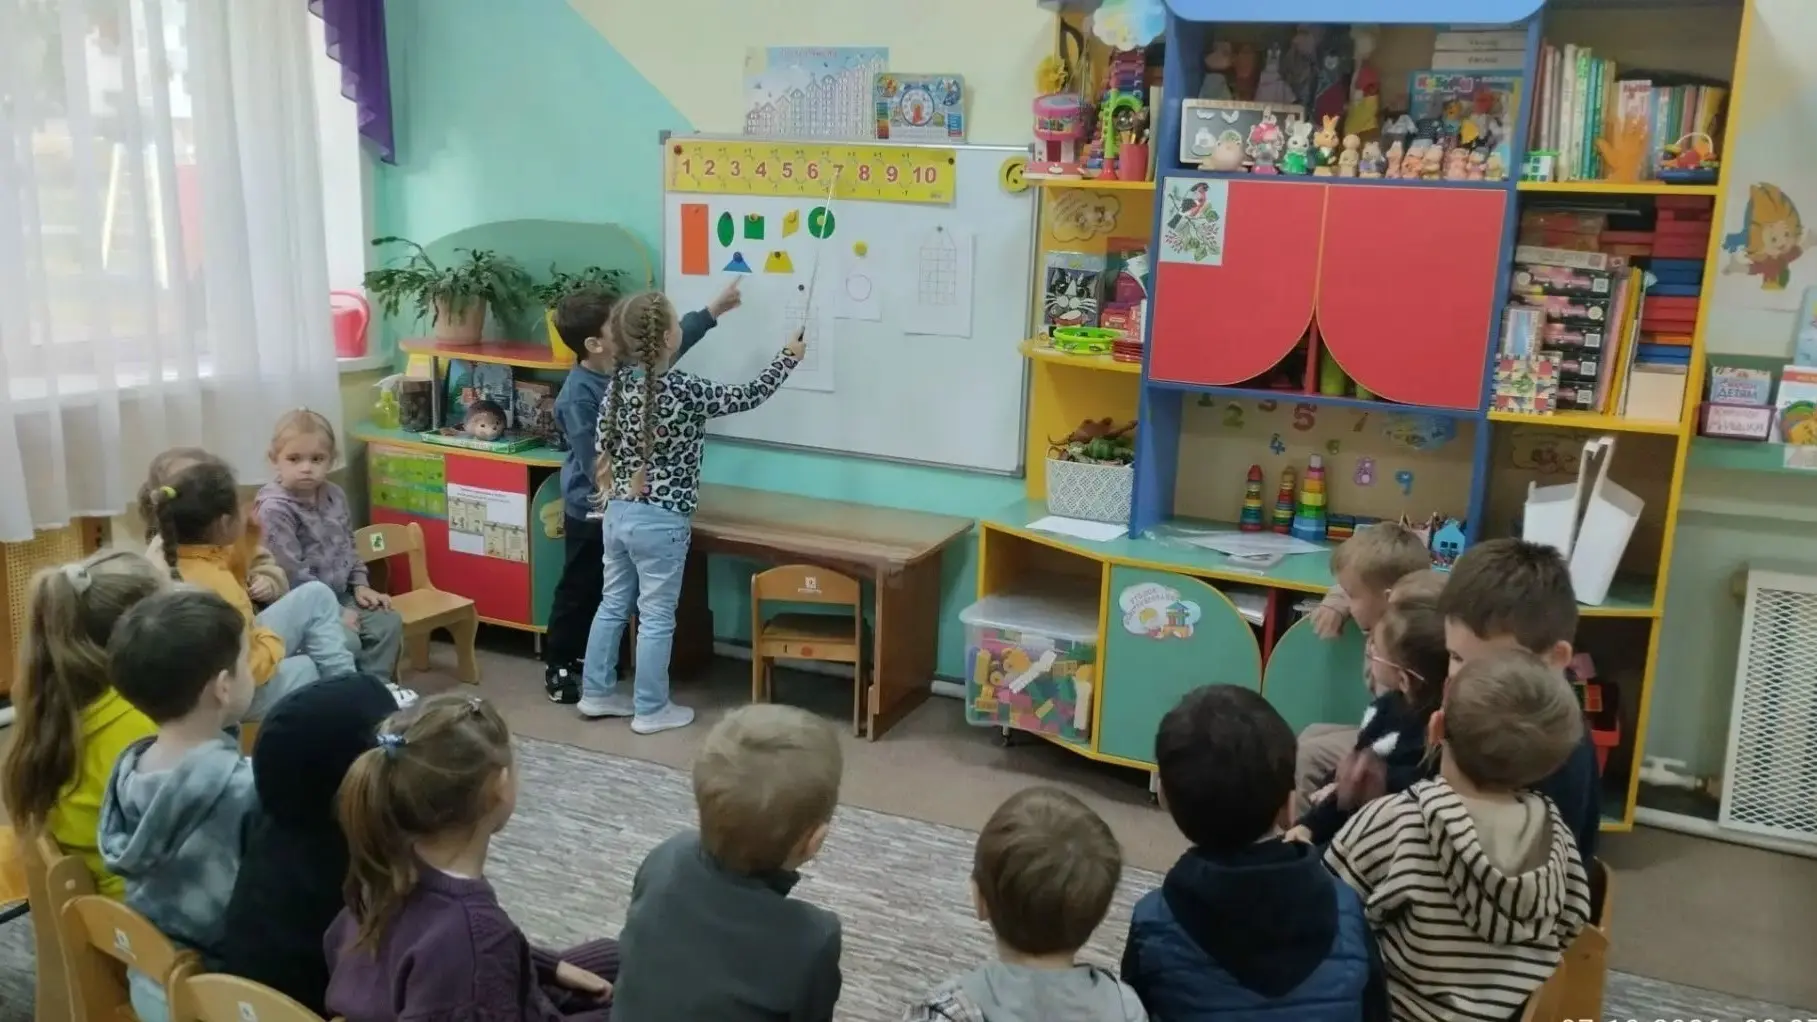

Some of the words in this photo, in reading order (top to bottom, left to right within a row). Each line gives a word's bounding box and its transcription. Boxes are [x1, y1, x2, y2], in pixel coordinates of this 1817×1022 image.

[682, 159, 690, 174] 1
[704, 160, 715, 175] 2
[731, 161, 740, 176] 3
[755, 162, 767, 177] 4
[782, 162, 793, 178] 5
[807, 163, 819, 179] 6
[832, 164, 844, 179] 7
[858, 164, 870, 181] 8
[886, 166, 898, 182] 9
[913, 166, 937, 183] 10
[1223, 402, 1244, 429] 2
[1293, 402, 1317, 431] 5
[1269, 433, 1286, 456] 4
[1354, 457, 1377, 486] 8
[1395, 470, 1414, 495] 9
